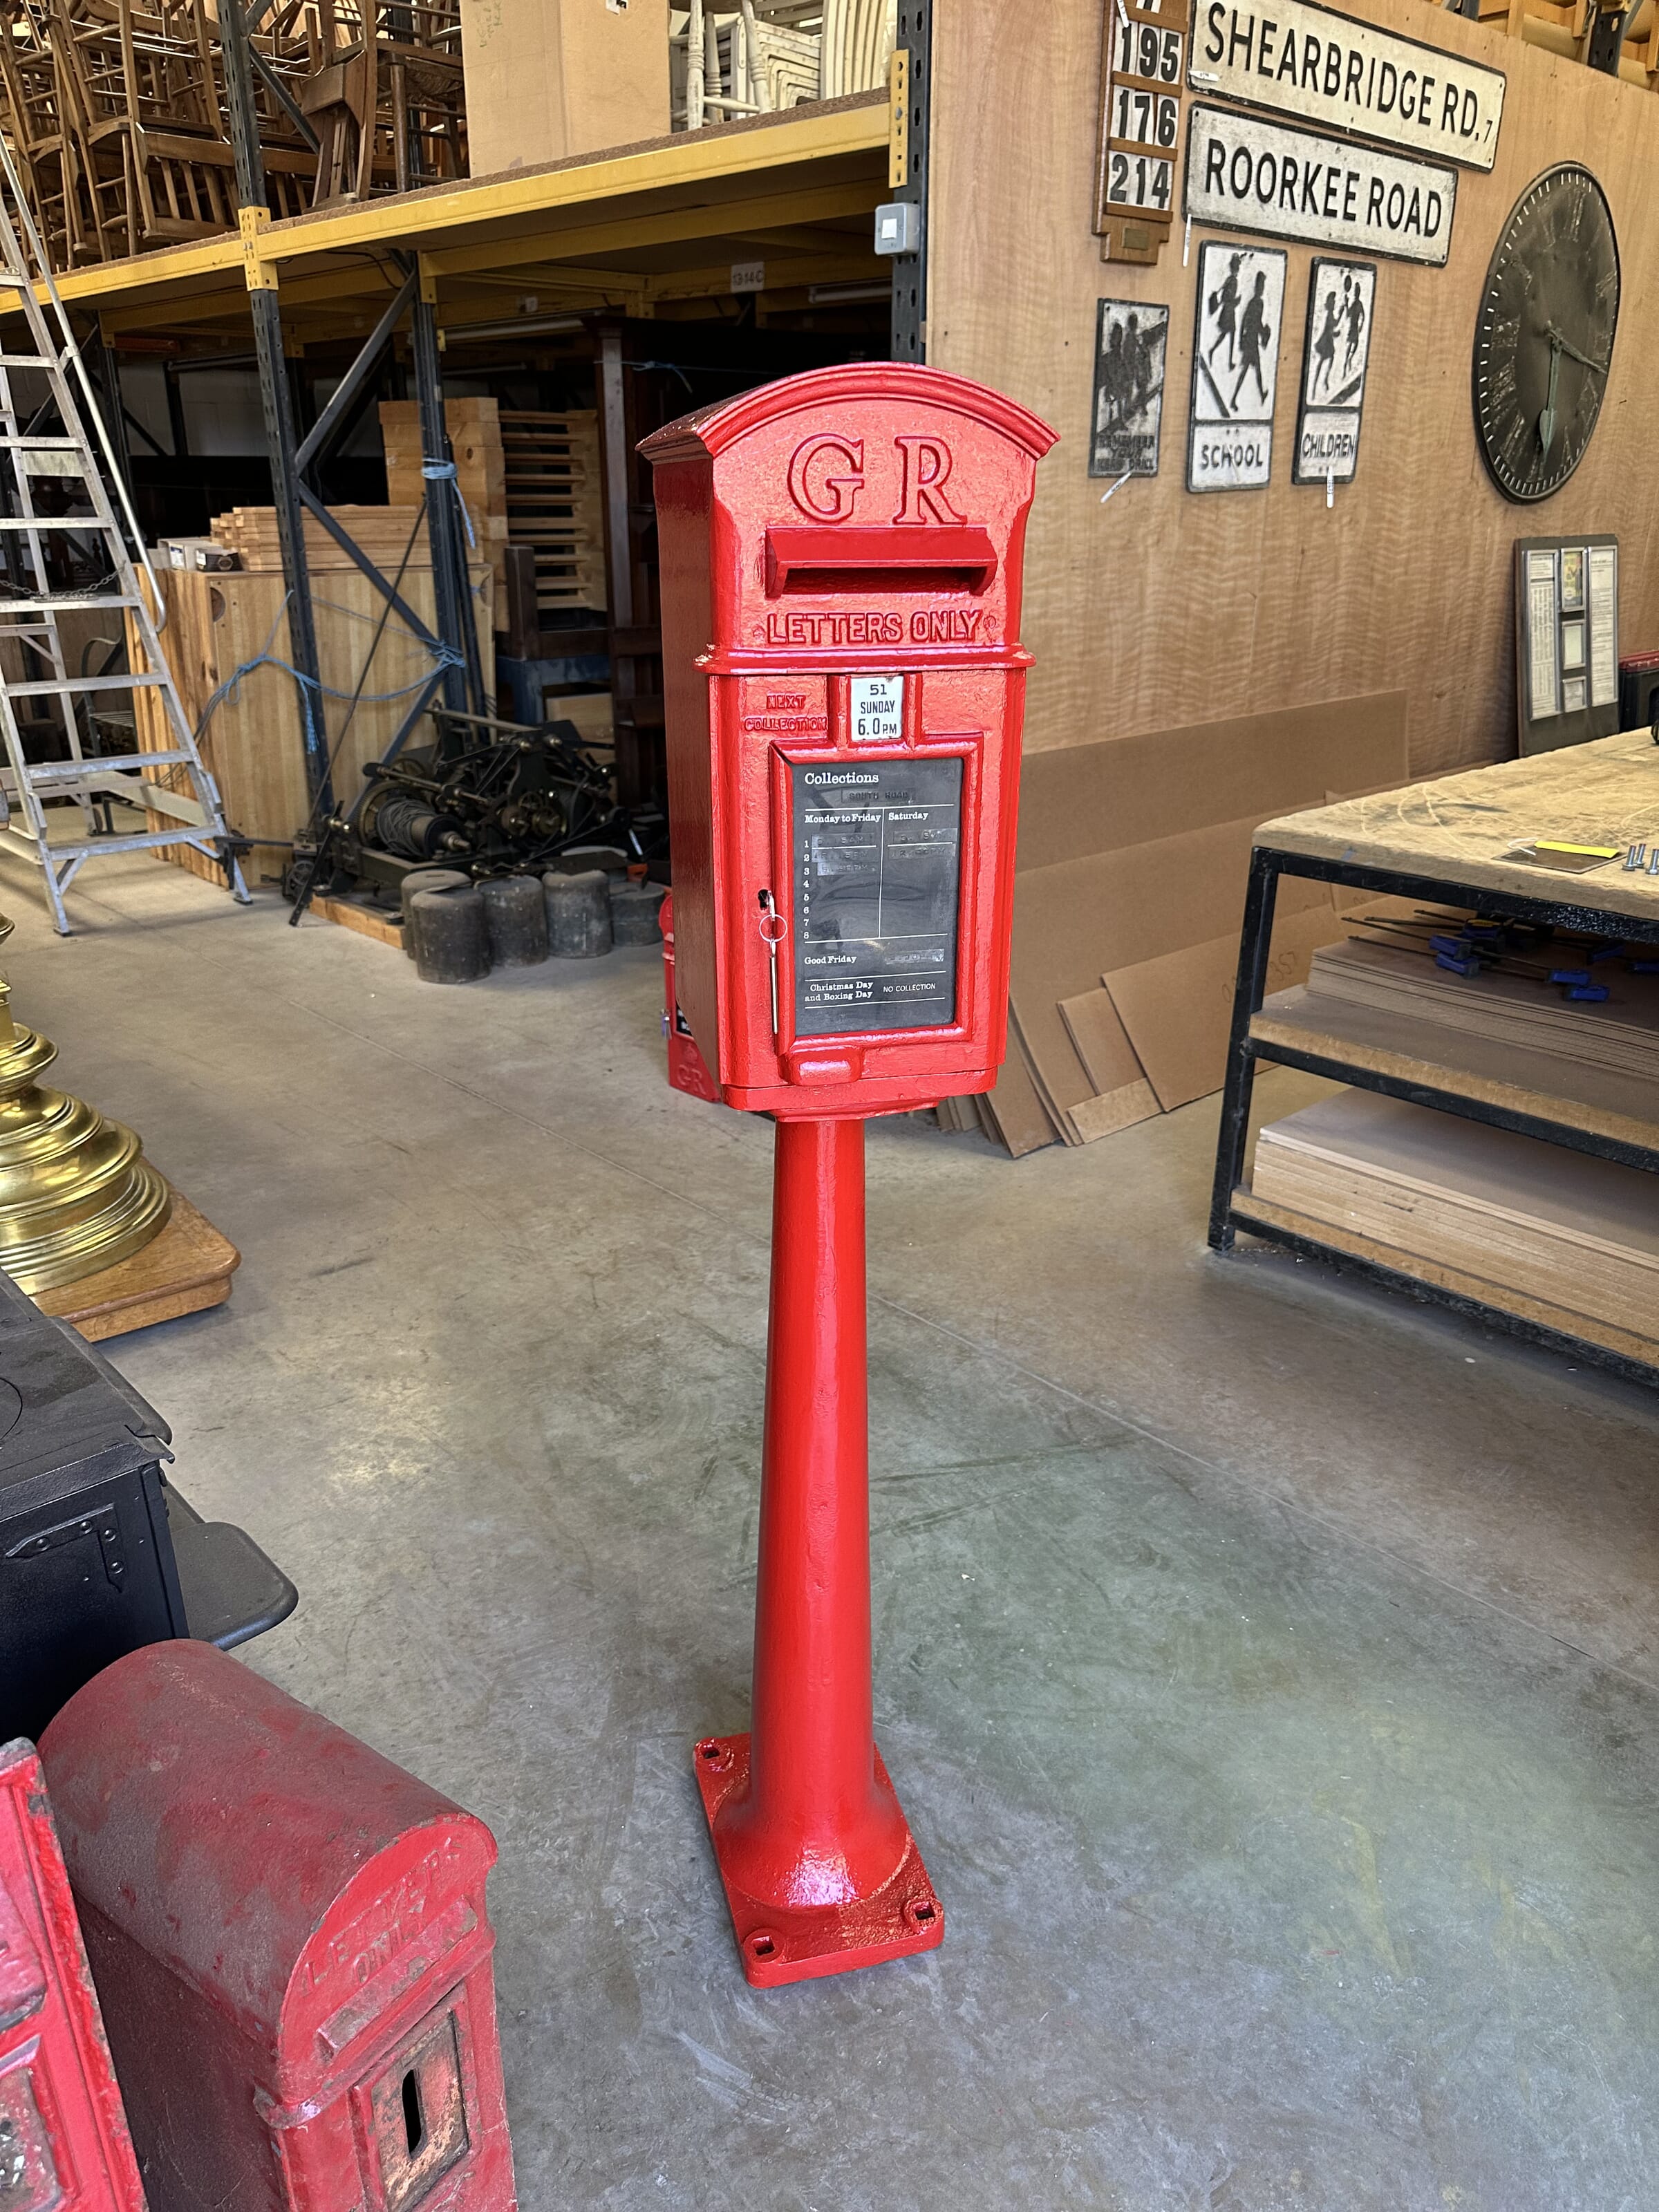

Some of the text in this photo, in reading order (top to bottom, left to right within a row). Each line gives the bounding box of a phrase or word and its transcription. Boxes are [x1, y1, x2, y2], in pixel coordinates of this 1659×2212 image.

[1121, 24, 1179, 82] 195
[1206, 2, 1435, 126] SHEARBRIDGE
[1441, 83, 1479, 140] RD.
[1119, 90, 1176, 147] 176
[1109, 154, 1170, 209] 214
[1206, 138, 1442, 238] ROORKEE ROAD
[1302, 433, 1355, 458] CHILDREN
[1201, 444, 1263, 470] SCHOOL
[767, 609, 983, 644] LETTERS ONLY
[870, 684, 887, 695] 51
[766, 693, 806, 709] NEXT
[861, 700, 895, 714] SUNDAY
[744, 716, 828, 731] COLLECTION
[858, 718, 881, 735] 6.0
[805, 772, 879, 785] Collections
[805, 815, 840, 823] Monday
[851, 814, 881, 823] Friday
[888, 812, 928, 821] Saturday
[805, 955, 857, 964] Good Friday
[810, 981, 873, 992] Christmas Day
[895, 983, 936, 993] COLLECTION
[823, 993, 854, 1001] Boxing
[855, 991, 873, 999] Day
